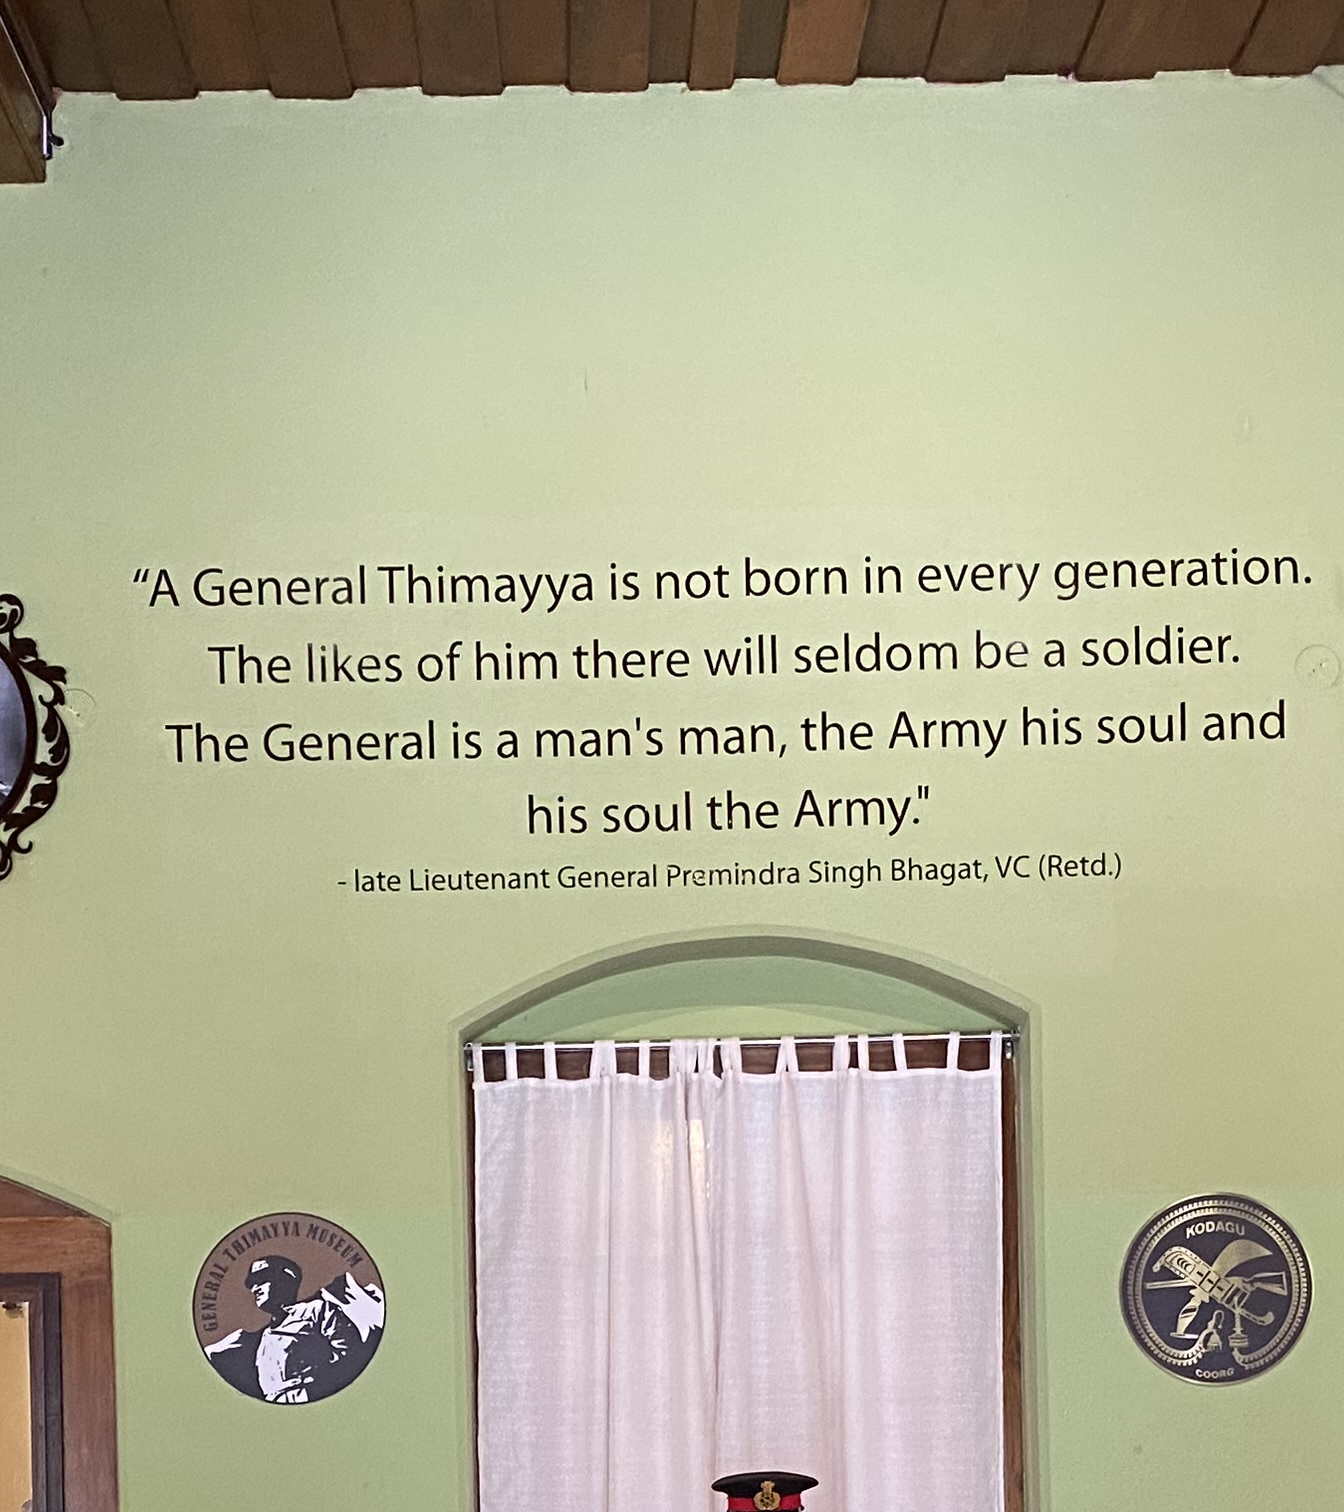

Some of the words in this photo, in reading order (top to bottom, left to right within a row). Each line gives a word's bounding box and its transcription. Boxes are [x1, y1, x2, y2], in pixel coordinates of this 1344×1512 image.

[192, 564, 367, 607] General
[376, 563, 594, 614] Thimayya
[609, 562, 641, 601] is
[655, 564, 730, 600] not
[744, 556, 848, 597] born
[864, 555, 902, 595] in
[917, 562, 1041, 603] every
[1053, 547, 1312, 602] generation.
[207, 643, 292, 685] The
[306, 642, 403, 684] likes
[416, 640, 464, 683] of
[475, 640, 558, 681] him
[571, 638, 691, 681] there
[703, 633, 778, 677] will
[793, 631, 959, 674] seldom
[975, 628, 1030, 670] be
[1043, 639, 1066, 668] a
[1081, 624, 1240, 668] soldier.
[164, 721, 250, 764] The
[262, 718, 436, 763] General
[451, 720, 483, 760] is
[496, 729, 519, 760] a
[535, 716, 664, 758] man's
[679, 723, 788, 759] man,
[799, 710, 874, 752] the
[887, 710, 1008, 759] Army
[1022, 705, 1083, 747] his
[1096, 701, 1187, 745] soul
[1202, 698, 1286, 742] and
[527, 793, 588, 835] his
[602, 790, 692, 834] soul
[705, 789, 780, 831] the
[353, 866, 402, 894] late
[408, 865, 550, 893] Lieutenant
[556, 862, 658, 892] General
[665, 860, 801, 888] Premindra
[808, 857, 882, 890] Singh
[890, 856, 990, 887] Bhagat,
[994, 854, 1032, 881] VC
[1038, 851, 1122, 882] (Retd.)
[1186, 1221, 1246, 1239] KODAGU
[202, 1263, 230, 1333] GENERAL
[224, 1220, 301, 1262] THIMAYYA
[305, 1223, 365, 1267] MUSEUM
[1194, 1368, 1235, 1379] COORG
